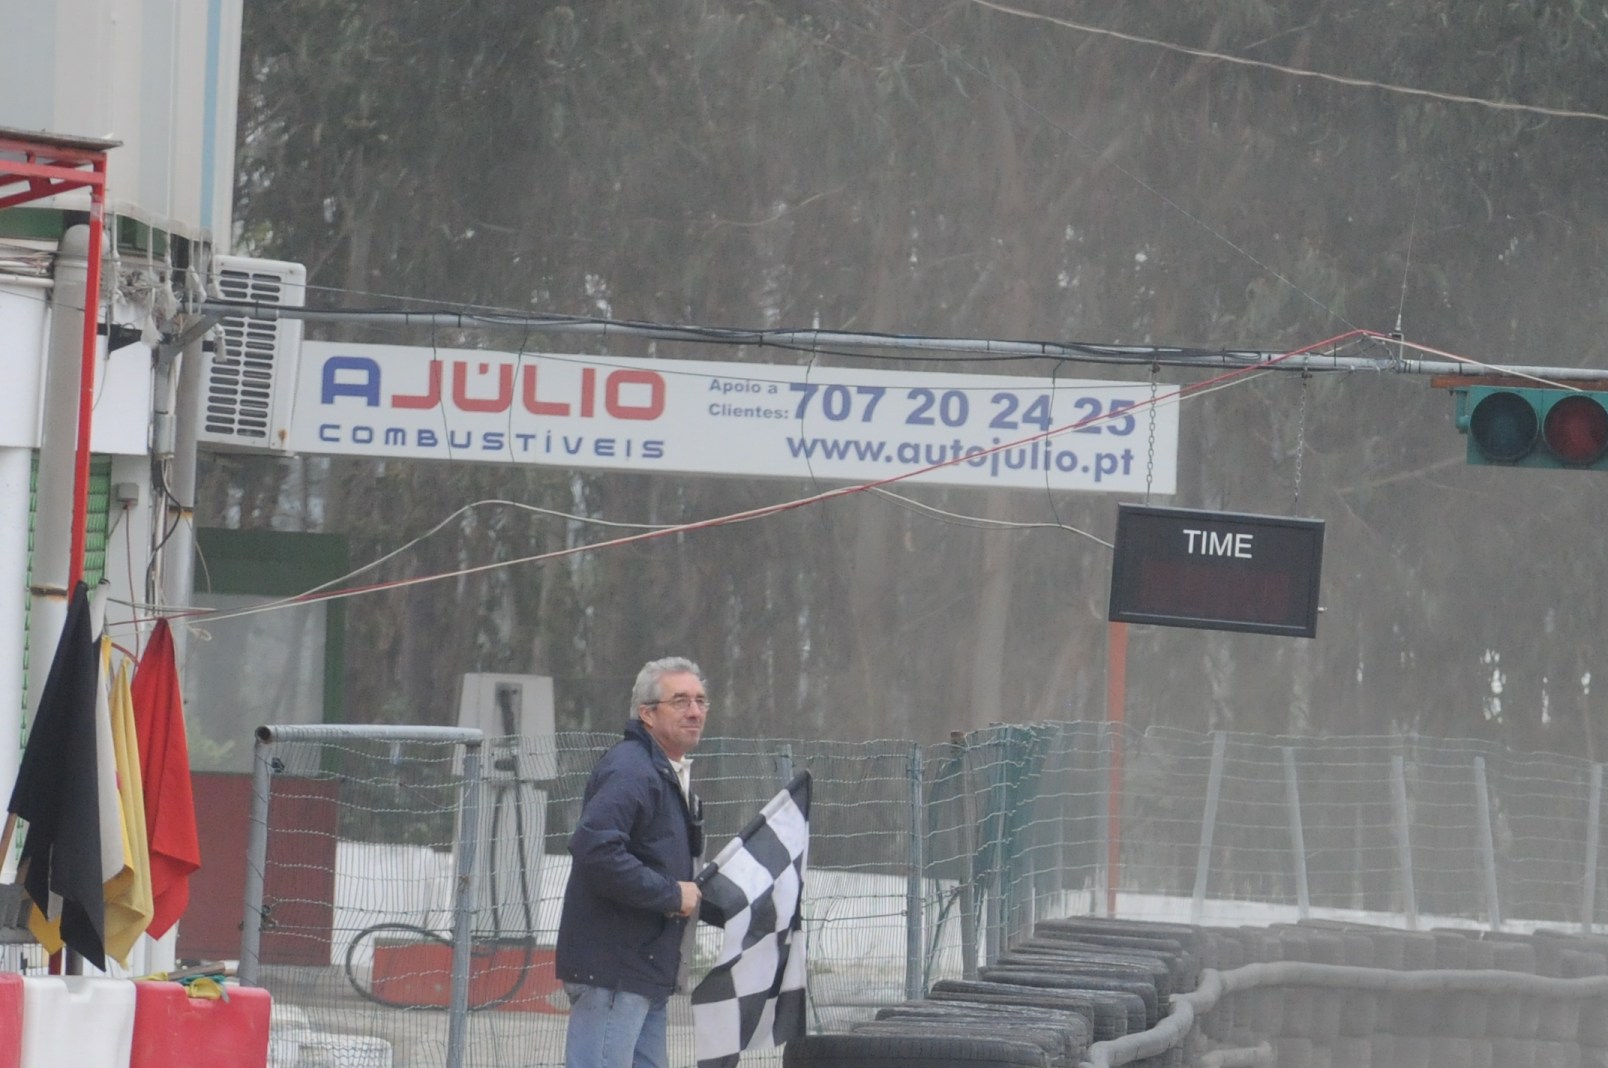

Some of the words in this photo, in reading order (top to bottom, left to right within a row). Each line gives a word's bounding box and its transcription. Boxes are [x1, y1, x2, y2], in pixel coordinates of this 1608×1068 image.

[709, 379, 761, 395] Apoio
[767, 383, 778, 394] a
[708, 402, 789, 420] Clientes:
[789, 382, 887, 423] 707
[905, 387, 970, 428] 20
[989, 392, 1055, 432] 24
[1072, 396, 1137, 437] 25
[318, 423, 665, 459] COMBUSTÍVEIS
[785, 434, 1136, 482] www.autojulio.pt
[1183, 529, 1253, 559] TIME
